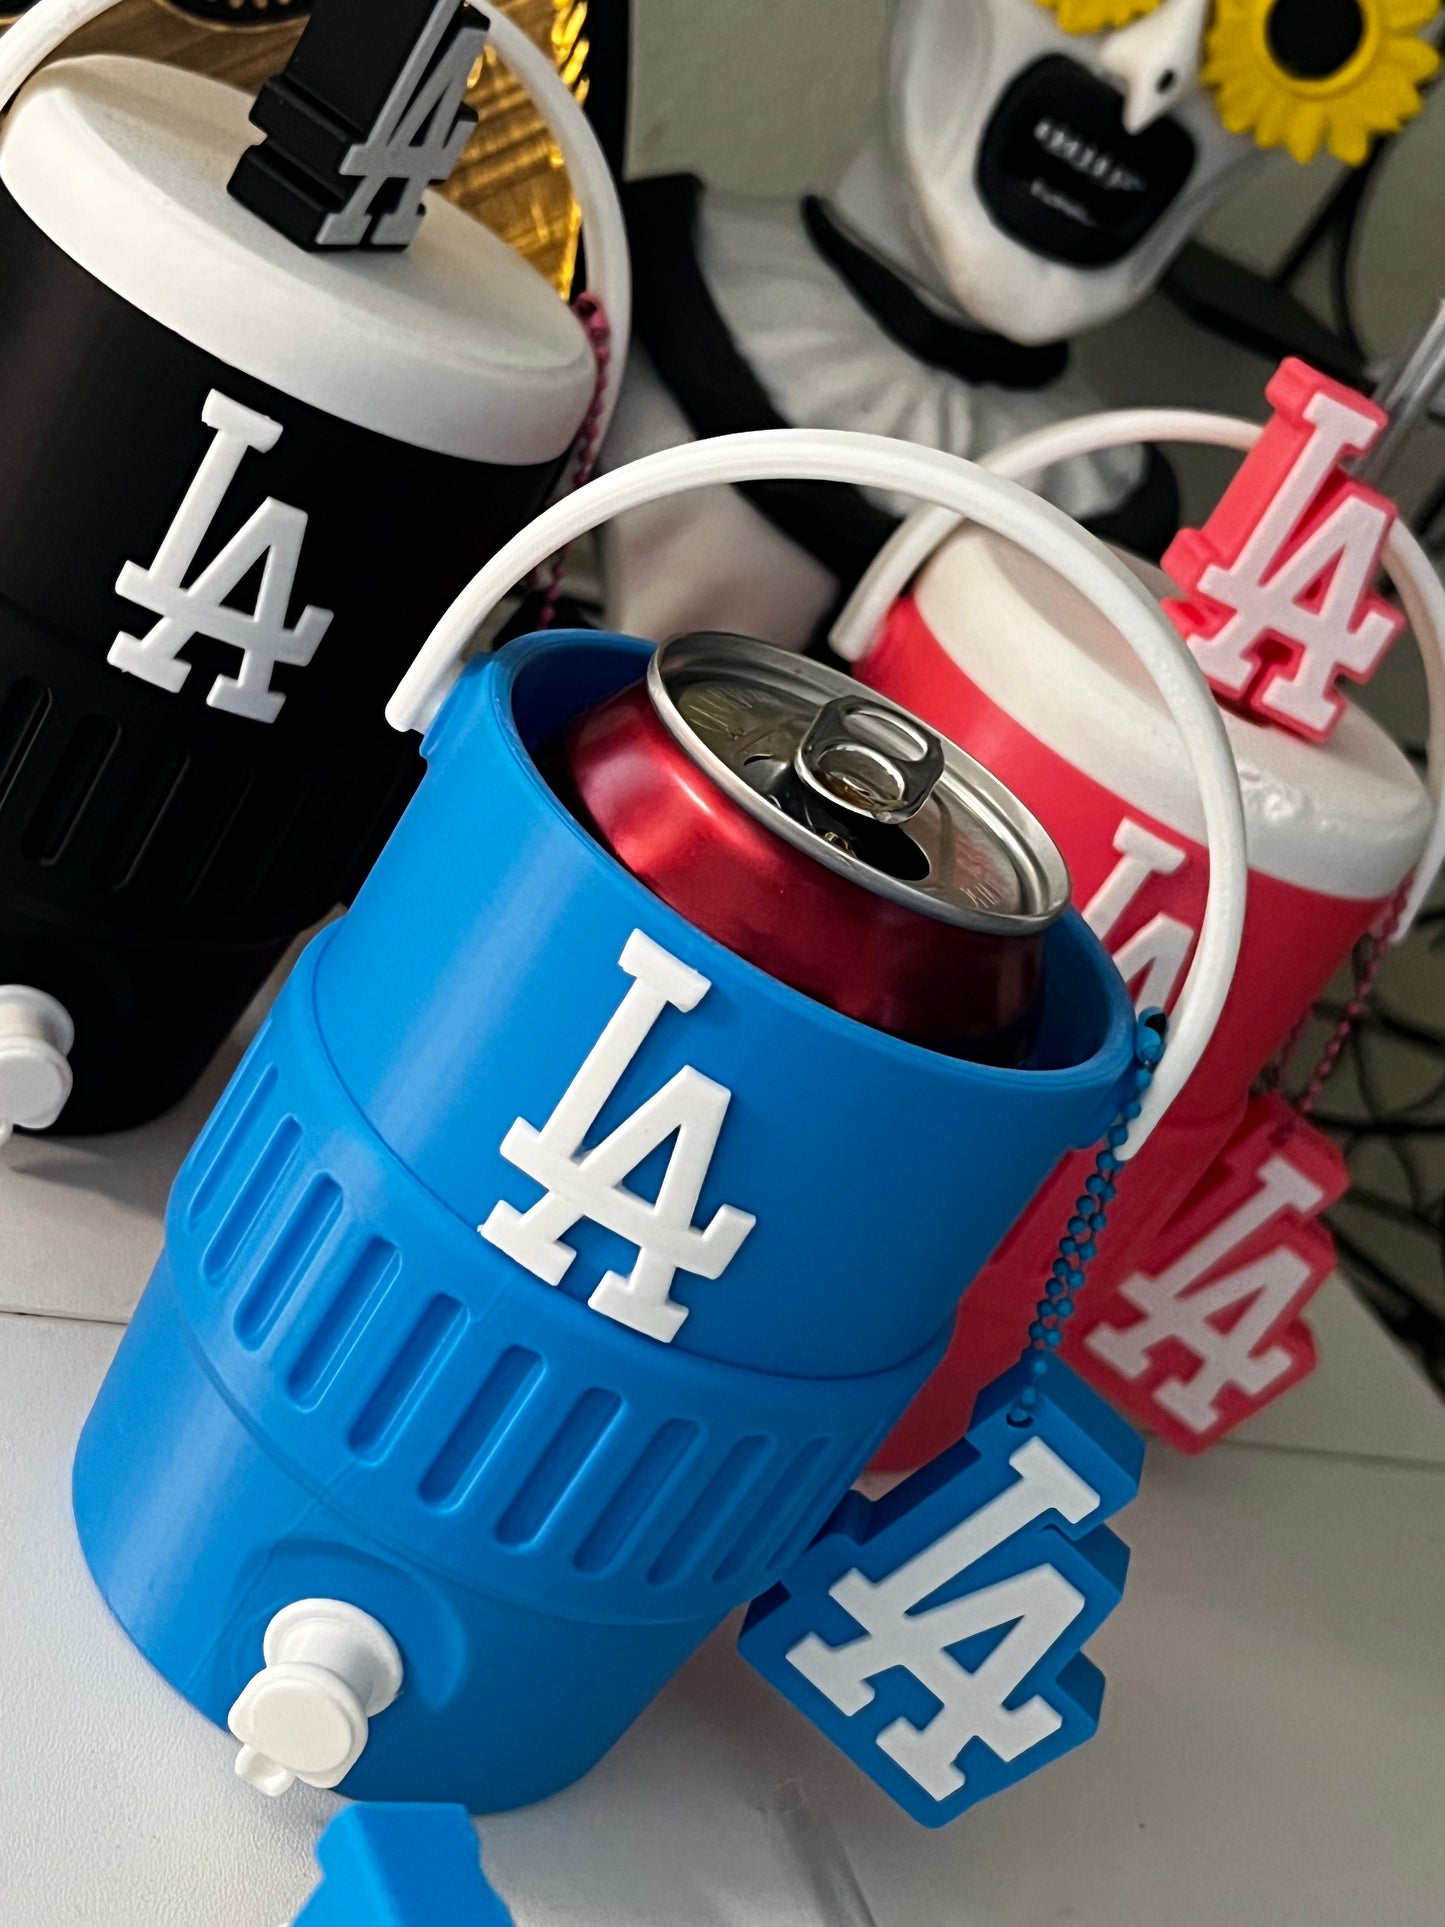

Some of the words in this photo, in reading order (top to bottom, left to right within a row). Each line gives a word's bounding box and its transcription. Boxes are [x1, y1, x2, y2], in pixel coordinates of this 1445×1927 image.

[316, 0, 489, 245] LA
[107, 388, 334, 724] LA
[1187, 392, 1397, 731] LA
[478, 928, 756, 1343] LA
[1084, 1156, 1323, 1433] LA
[785, 1436, 1100, 1801] LA
